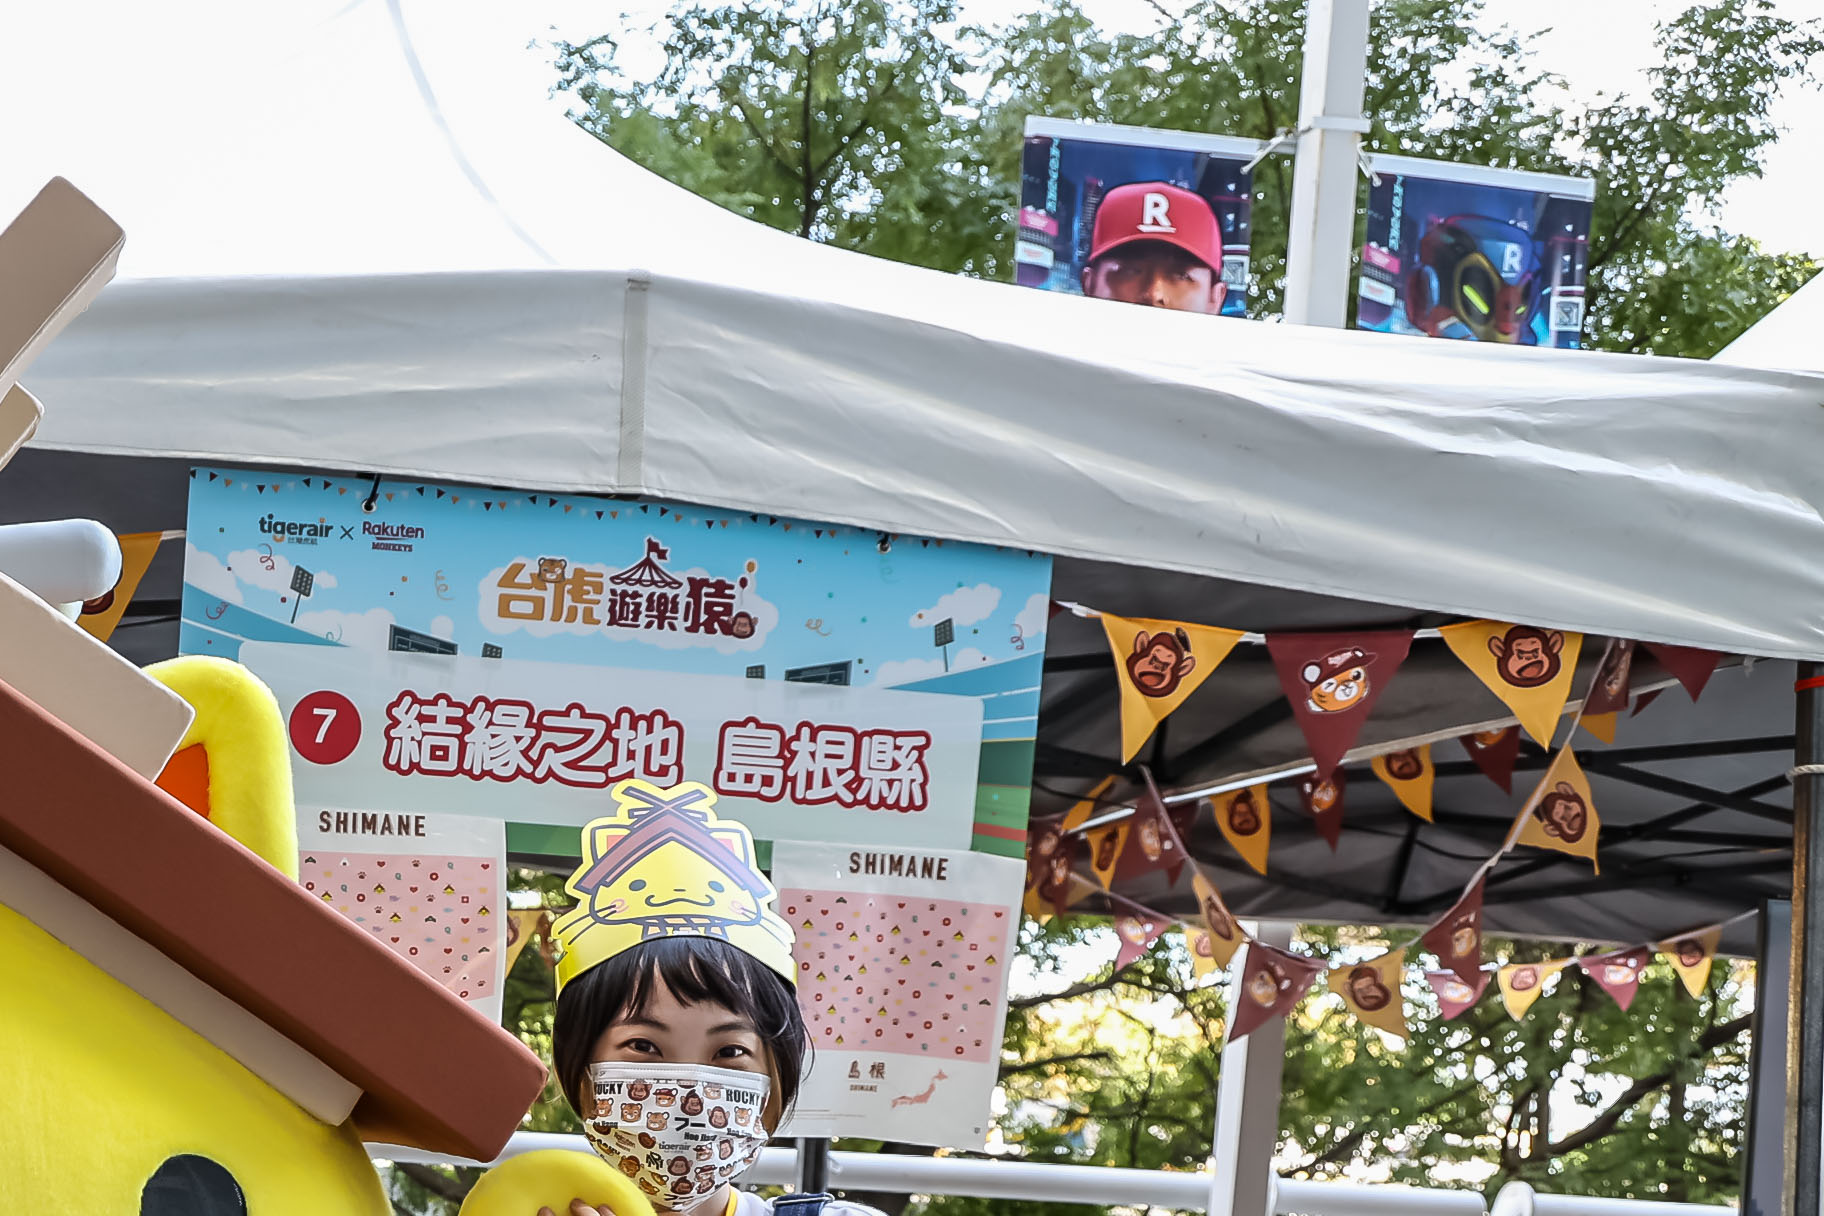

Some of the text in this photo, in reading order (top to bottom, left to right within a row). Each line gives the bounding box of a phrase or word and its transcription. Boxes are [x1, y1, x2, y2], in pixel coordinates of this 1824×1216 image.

[259, 513, 334, 541] tigerair
[362, 520, 425, 540] Rakuten
[311, 707, 338, 744] 7
[719, 715, 929, 811] 島根縣
[318, 810, 426, 838] SHIMANE
[848, 851, 950, 881] SHIMANE
